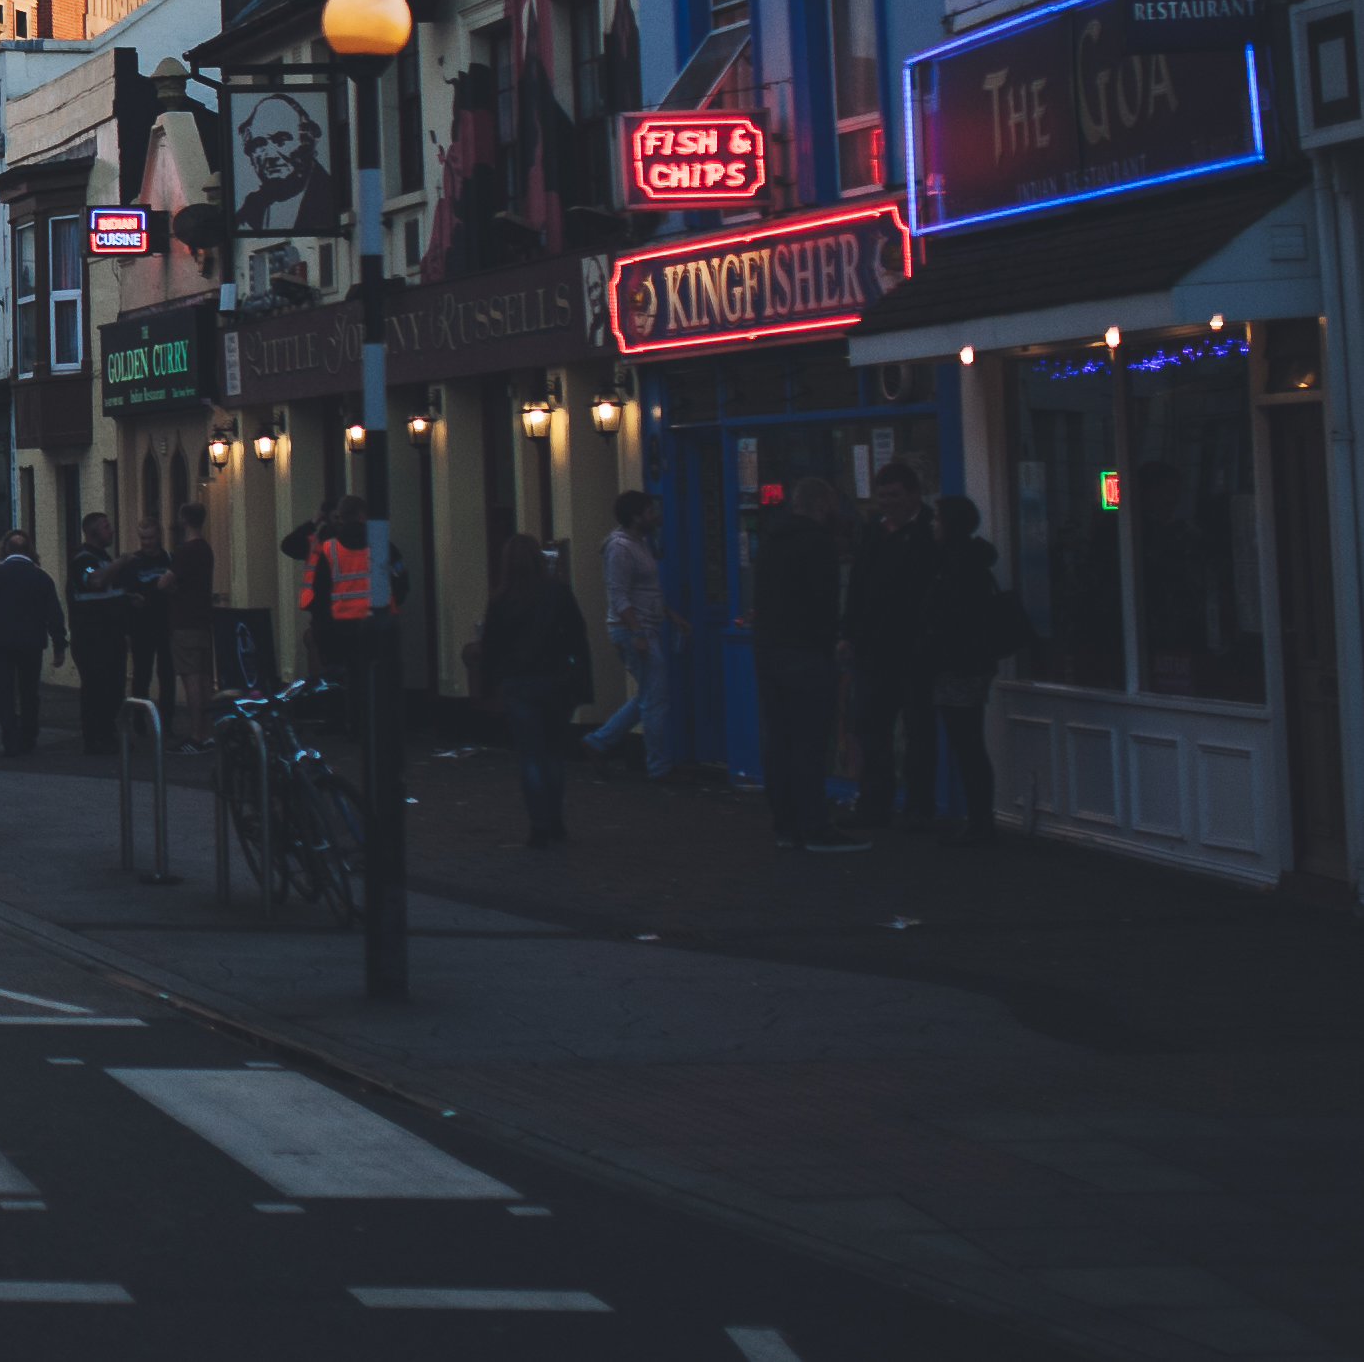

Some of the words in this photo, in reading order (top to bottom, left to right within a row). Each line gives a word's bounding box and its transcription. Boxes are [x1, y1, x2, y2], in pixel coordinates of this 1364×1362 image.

[643, 128, 718, 156] FISH
[728, 127, 753, 155] &
[649, 161, 747, 189] CHIPS
[96, 232, 142, 246] CUISINE
[663, 234, 866, 330] KINGFISHER
[246, 331, 320, 379] LITTLE
[428, 283, 572, 351] RUSSELLS
[107, 347, 149, 384] GOLDEN
[152, 339, 189, 376] CURRY
